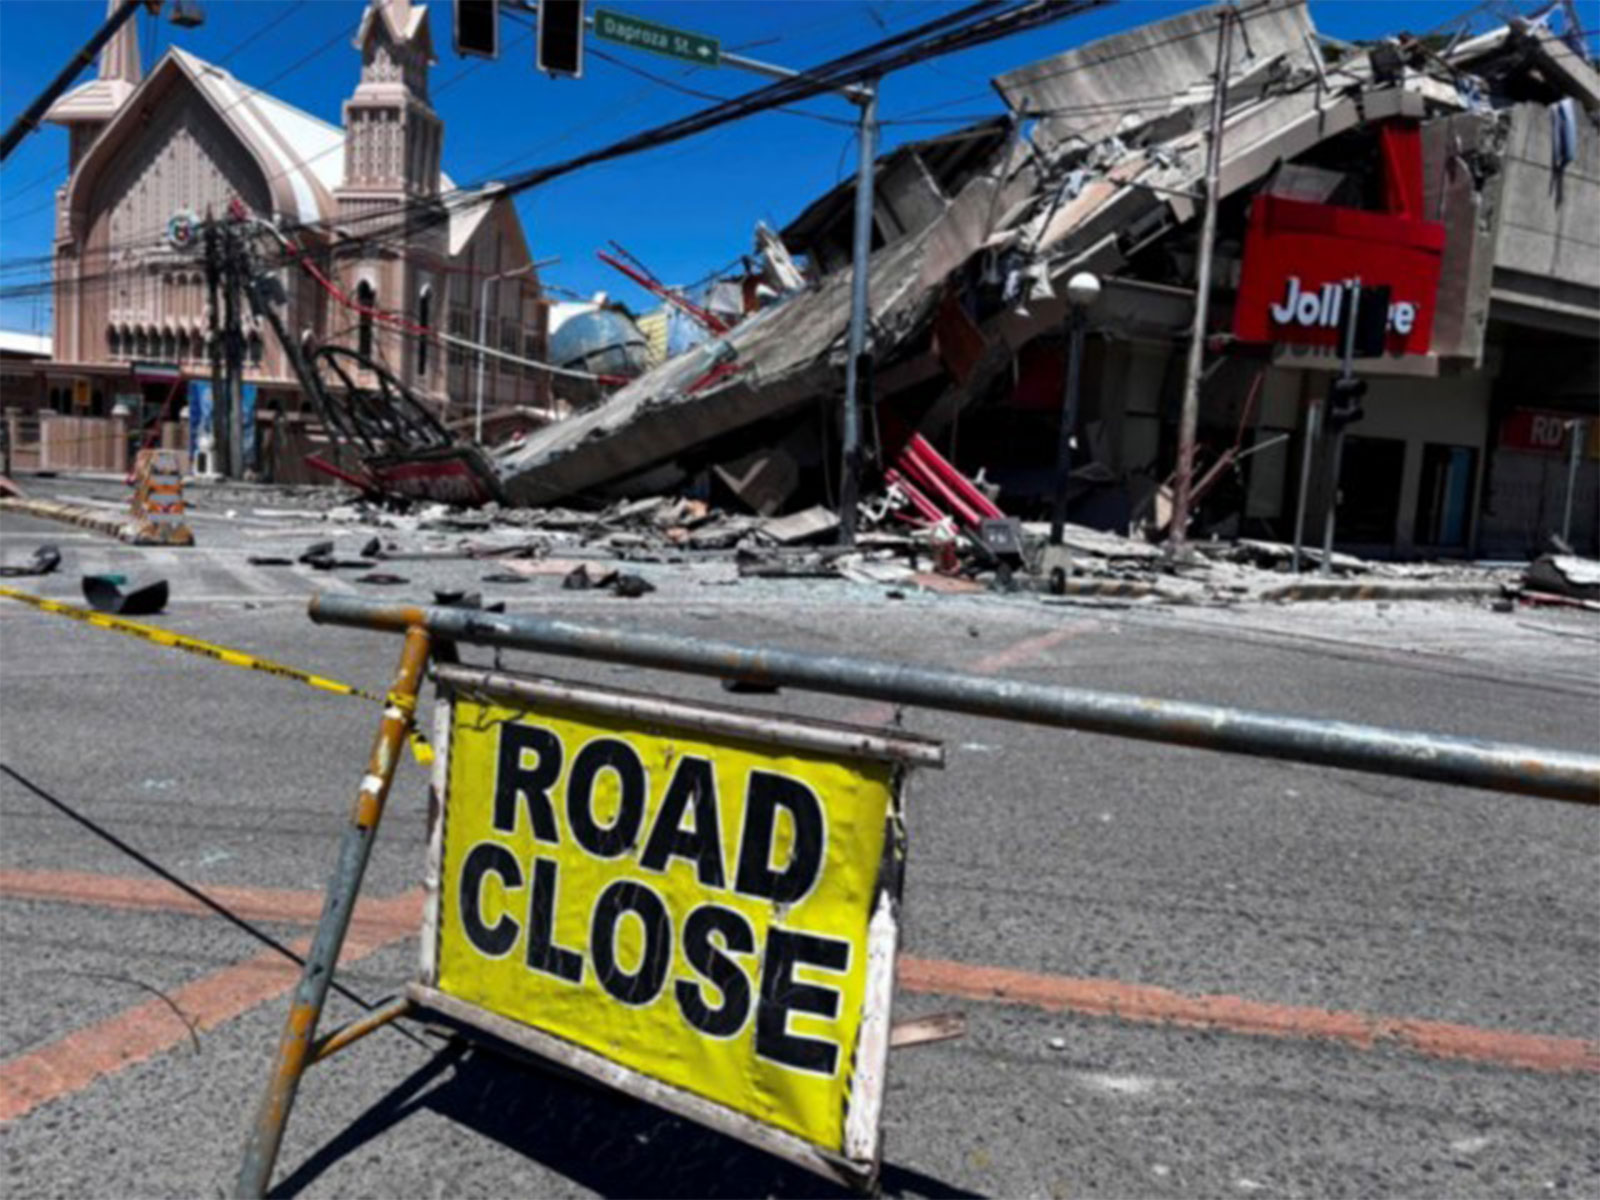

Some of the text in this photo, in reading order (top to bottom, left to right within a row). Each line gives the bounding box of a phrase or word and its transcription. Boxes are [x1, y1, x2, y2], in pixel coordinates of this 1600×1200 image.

[603, 17, 669, 48] Daproza
[1270, 275, 1416, 334] Jolle
[493, 721, 826, 905] ROAD
[458, 841, 851, 1076] CLOSE
